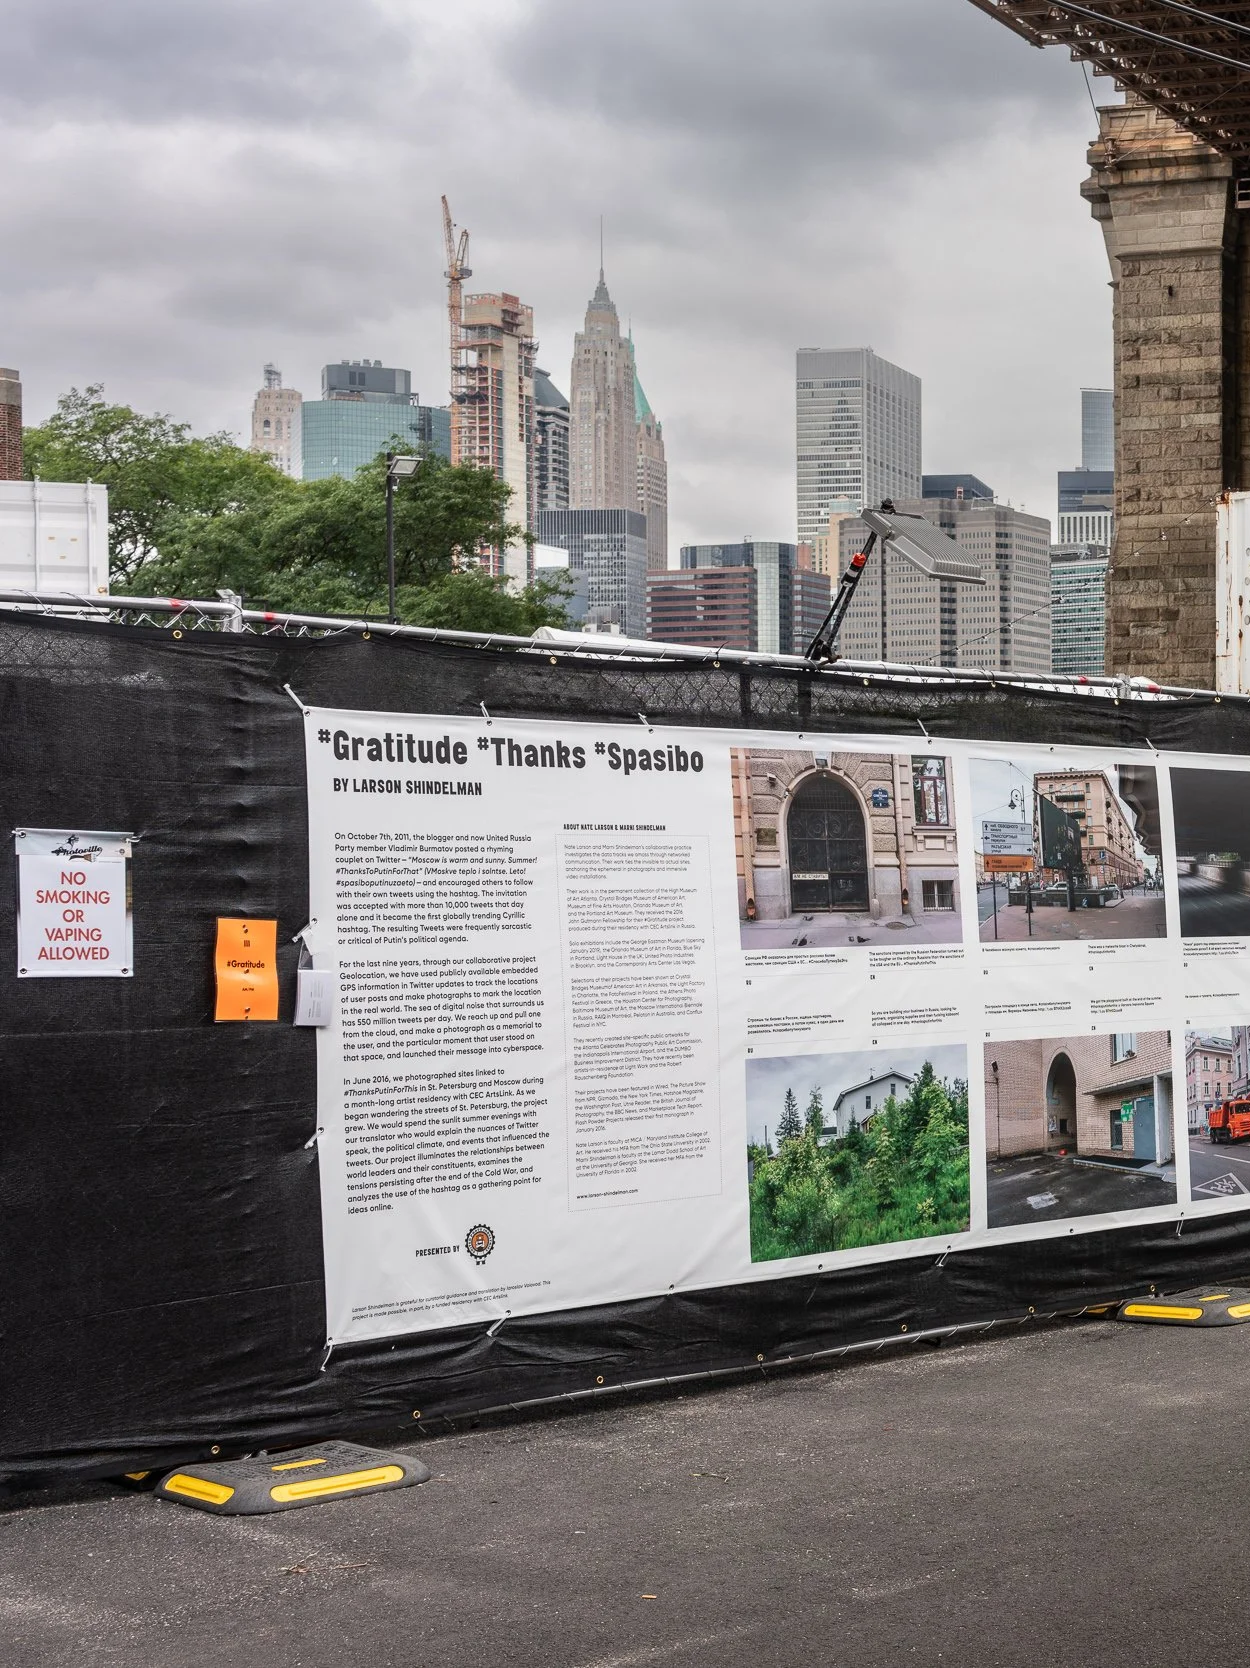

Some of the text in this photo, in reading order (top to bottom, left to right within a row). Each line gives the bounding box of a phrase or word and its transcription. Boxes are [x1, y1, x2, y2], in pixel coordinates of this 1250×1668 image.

[318, 729, 703, 776] #Gratitude #Thanks #Spasibo
[333, 778, 482, 795] BY LARSON SHINDELMAN
[379, 833, 393, 841] 7th,
[426, 834, 454, 842] blogger
[335, 844, 355, 853] Party
[487, 846, 514, 854] rhyming
[335, 856, 363, 864] couplet
[61, 872, 86, 885] NO
[36, 890, 110, 904] SMOKING
[62, 909, 84, 922] OR
[442, 913, 470, 921] globally
[472, 912, 501, 920] trending
[502, 912, 525, 920] Cyrillic
[45, 928, 102, 941] VAPING
[337, 926, 370, 934] hashtag.
[387, 925, 418, 933] resulting
[409, 936, 437, 944] political
[439, 936, 468, 944] agenda.
[38, 947, 109, 960] ALLOWED
[227, 960, 265, 970] #Gratitude
[416, 1245, 459, 1257] PRESENTED BY
